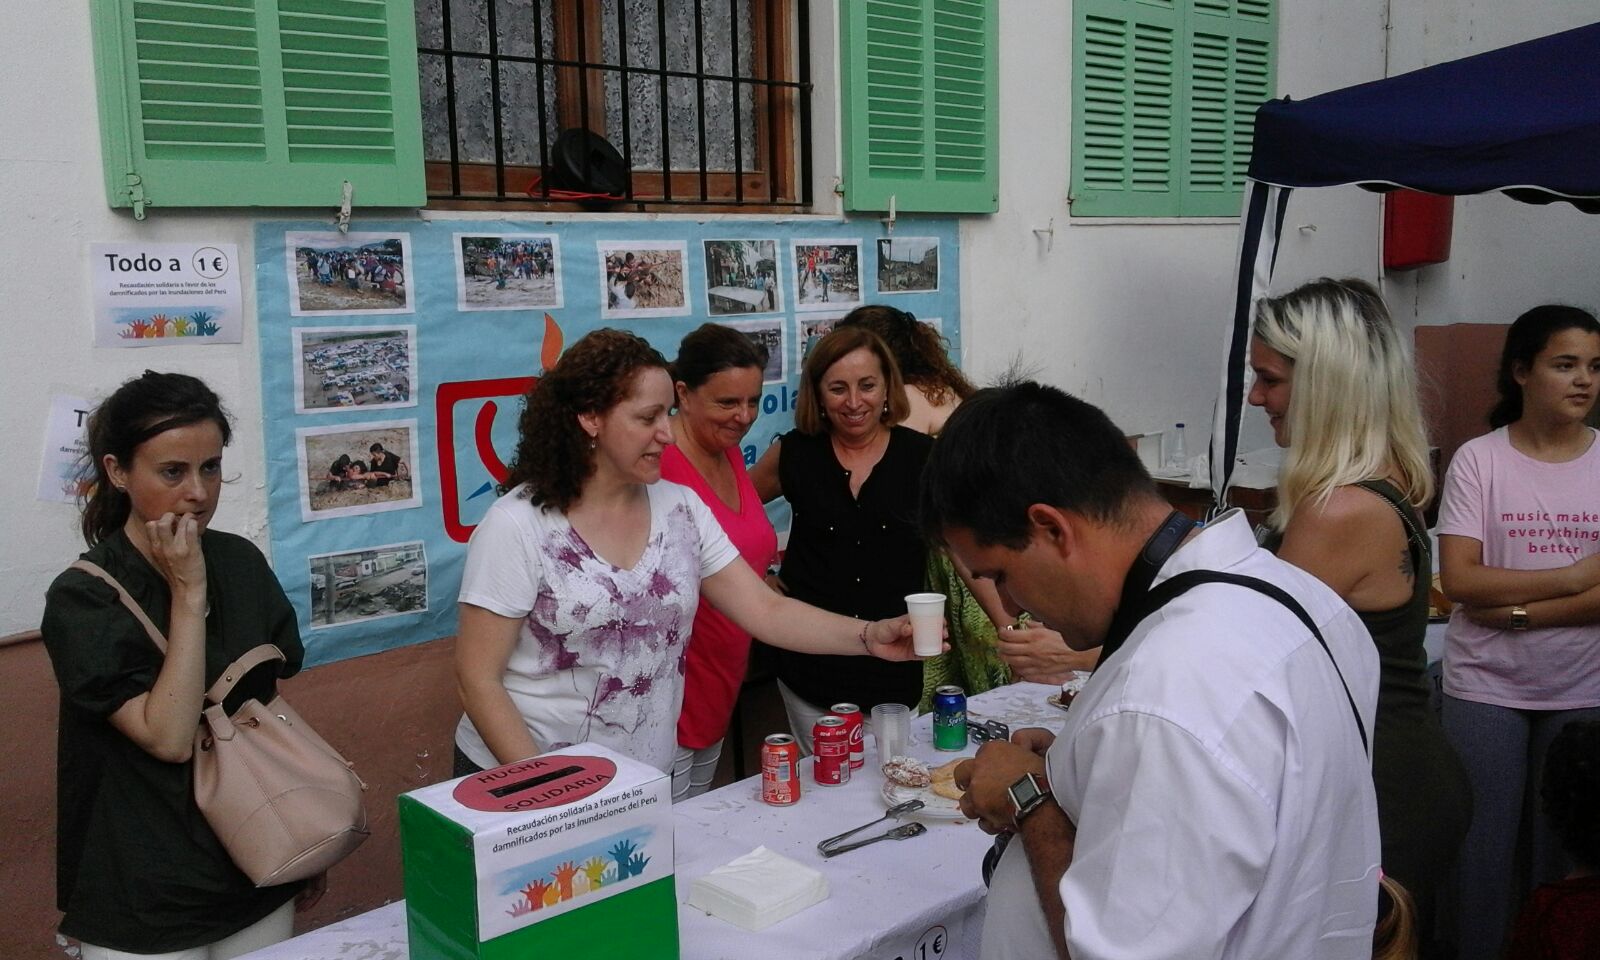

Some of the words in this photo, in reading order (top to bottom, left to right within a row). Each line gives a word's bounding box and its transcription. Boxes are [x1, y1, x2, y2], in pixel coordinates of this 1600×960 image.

[104, 253, 162, 271] Todo
[169, 258, 181, 271] a
[198, 258, 206, 271] 1
[212, 257, 223, 271] €
[1502, 510, 1551, 521] music
[1556, 511, 1599, 522] make
[1508, 527, 1600, 541] everything
[1528, 542, 1580, 554] better
[477, 761, 549, 783] HUCHA
[504, 773, 611, 811] SOLIDARIA
[506, 814, 558, 836] Recaudación
[559, 803, 593, 820] solidaria
[600, 795, 620, 807] favor
[621, 792, 631, 800] de
[632, 788, 643, 797] los
[492, 832, 548, 853] damnificados
[549, 827, 564, 838] por
[565, 822, 576, 831] las
[628, 801, 639, 811] del
[640, 794, 658, 807] Perú
